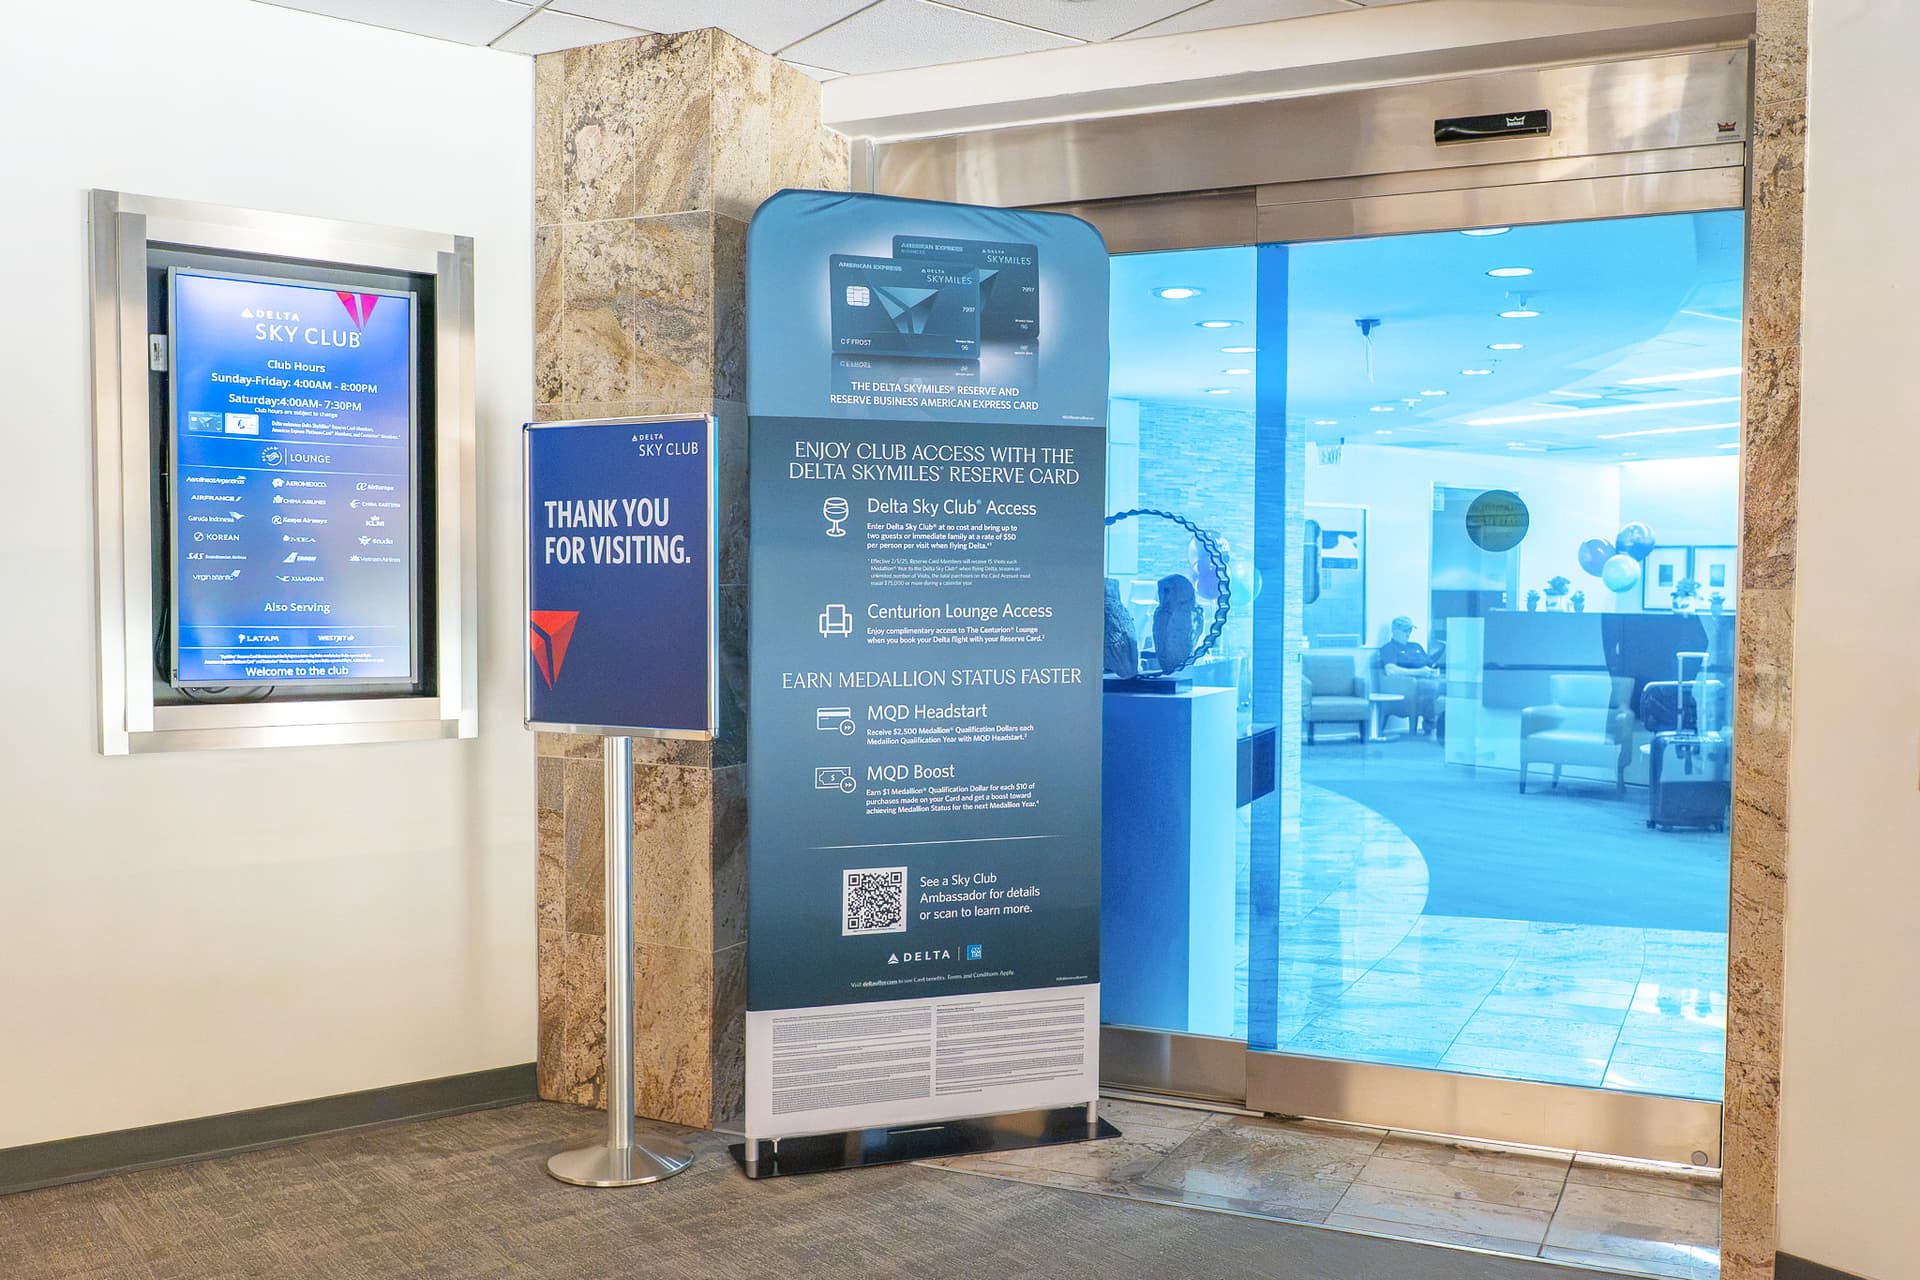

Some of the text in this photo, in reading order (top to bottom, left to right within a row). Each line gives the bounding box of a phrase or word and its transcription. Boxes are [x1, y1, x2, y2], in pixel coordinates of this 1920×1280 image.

[986, 254, 1031, 265] SKYMILES
[926, 274, 972, 284] SKYMILES
[255, 309, 300, 321] DELTA
[255, 322, 298, 342] SKY
[850, 338, 871, 346] FROST
[267, 359, 325, 372] Club Hours
[211, 372, 291, 389] Sunday-Friday:
[293, 378, 332, 390] 4:00AM
[340, 382, 377, 393] 8:00PM
[851, 381, 870, 391] THE
[872, 382, 901, 392] DELTA
[957, 385, 996, 395] RESERVE
[998, 387, 1019, 396] AND
[324, 400, 361, 411] 7:30PM
[830, 394, 1038, 410] RESERVE BUSINESS AMERICAN EXPRESS CARD
[254, 407, 267, 415] Club
[639, 441, 698, 456] SKY CLUB
[795, 441, 1074, 464] ENJOY CLUB ACCESS WITH THE
[289, 453, 330, 463] LOUNGE
[789, 462, 846, 479] DELTA
[949, 466, 1024, 483] RESERVE
[1029, 467, 1079, 484] CARD
[544, 497, 669, 528] THANK YOU
[867, 497, 907, 513] Delta
[912, 498, 938, 517] Sky
[985, 499, 1036, 515] Access
[866, 522, 885, 530] Enter
[885, 522, 904, 530] Delta
[905, 522, 917, 531] Sky
[970, 523, 983, 531] and
[983, 523, 1000, 532] bring
[880, 532, 902, 540] guests
[912, 532, 946, 540] immediate
[947, 532, 967, 541] family
[1003, 533, 1016, 541] $50
[545, 534, 690, 564] FOR VISITING.
[264, 602, 330, 614] Also Serving
[867, 603, 1052, 621] Centurion Lounge Access
[245, 666, 348, 676] Welcome to the club
[782, 667, 1081, 688] EARN MEDALLION STATUS FASTER
[867, 703, 987, 722] MQD Headstart
[867, 763, 955, 782] MQD Boost
[882, 787, 890, 796] $1
[927, 785, 968, 794] Qualification
[969, 784, 988, 792] Dollar
[999, 783, 1015, 791] each
[1015, 782, 1027, 790] $10
[1028, 782, 1035, 792] of
[865, 797, 899, 806] purchases
[900, 796, 918, 804] made
[928, 796, 943, 804] your
[944, 794, 960, 802] Card
[960, 793, 973, 801] and
[973, 794, 984, 802] get
[990, 792, 1008, 800] boost
[1009, 791, 1031, 801] toward
[865, 806, 896, 815] achieving
[897, 805, 929, 813] Medallion
[930, 804, 951, 812] Status
[920, 872, 997, 887] See a Sky Club
[919, 885, 1040, 903] Ambassador for details
[919, 904, 1032, 920] or scan to learn more.
[903, 949, 950, 962] DELTA
